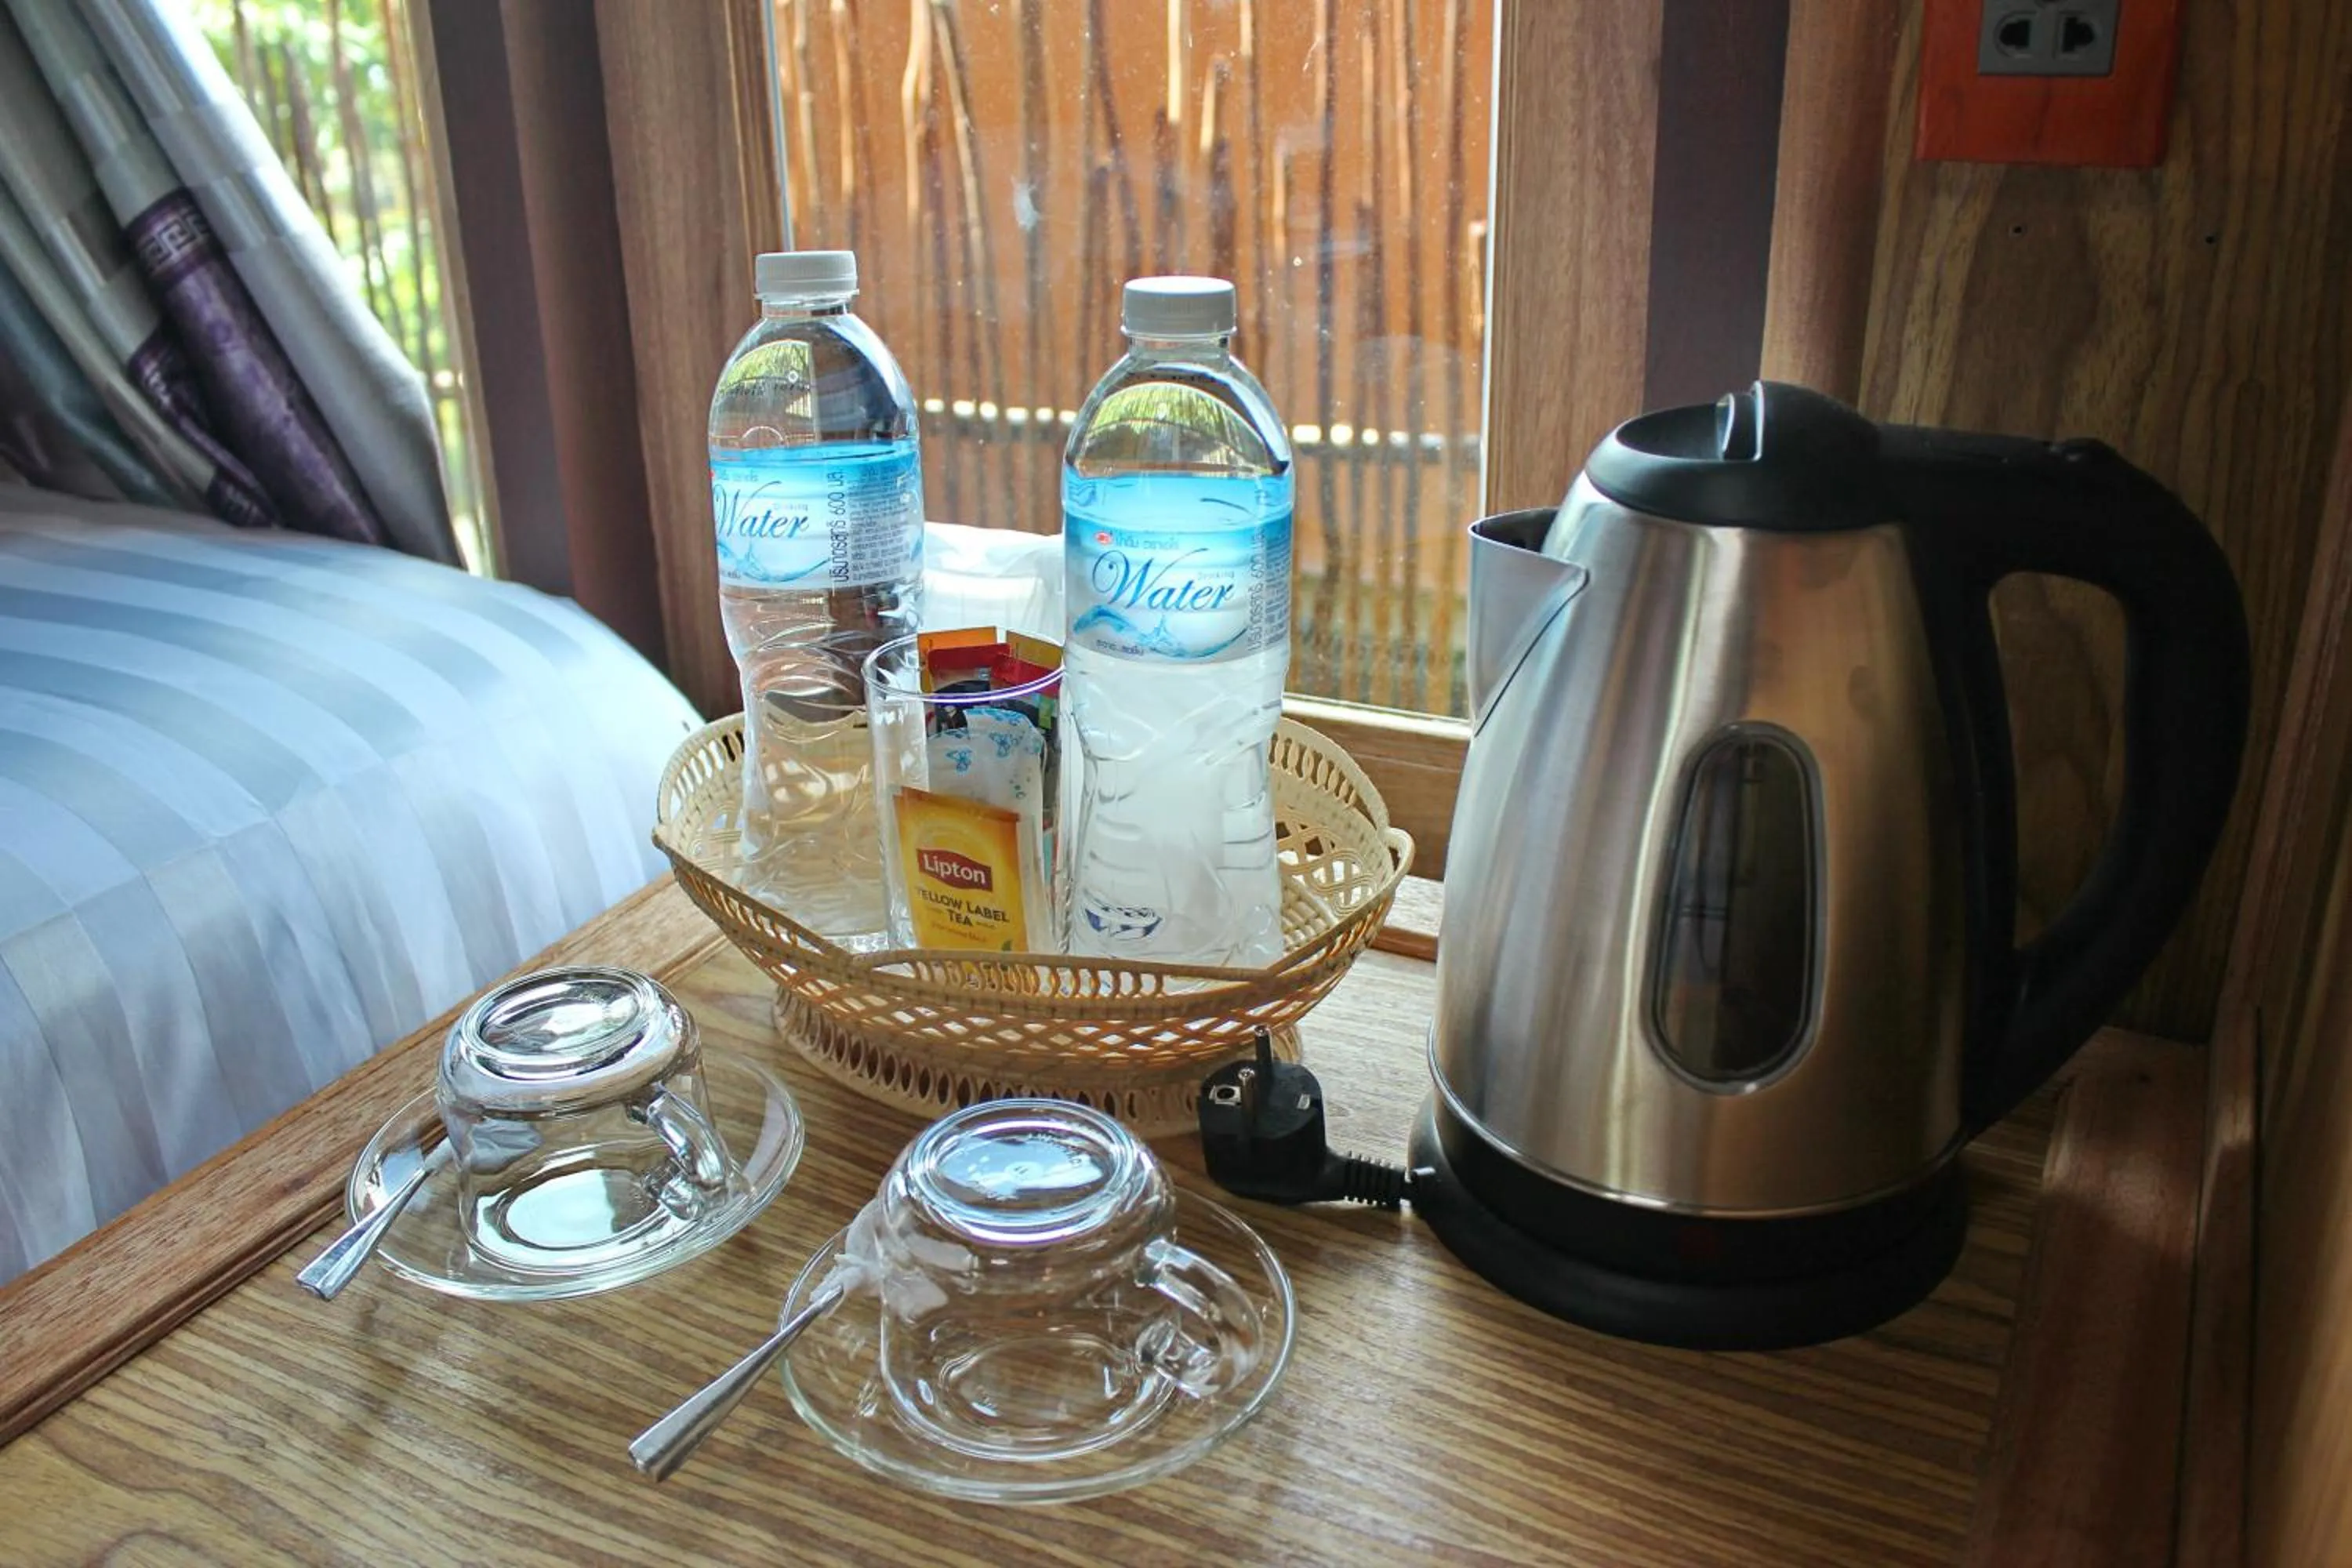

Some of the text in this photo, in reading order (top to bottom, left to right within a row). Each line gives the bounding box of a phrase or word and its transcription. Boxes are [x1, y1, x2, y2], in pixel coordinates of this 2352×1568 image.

[713, 480, 810, 539] Water
[827, 492, 846, 515] 600
[1092, 547, 1236, 611] Water
[923, 854, 986, 885] Lipton
[946, 909, 975, 927] TEA
[966, 900, 1011, 924] LABEL
